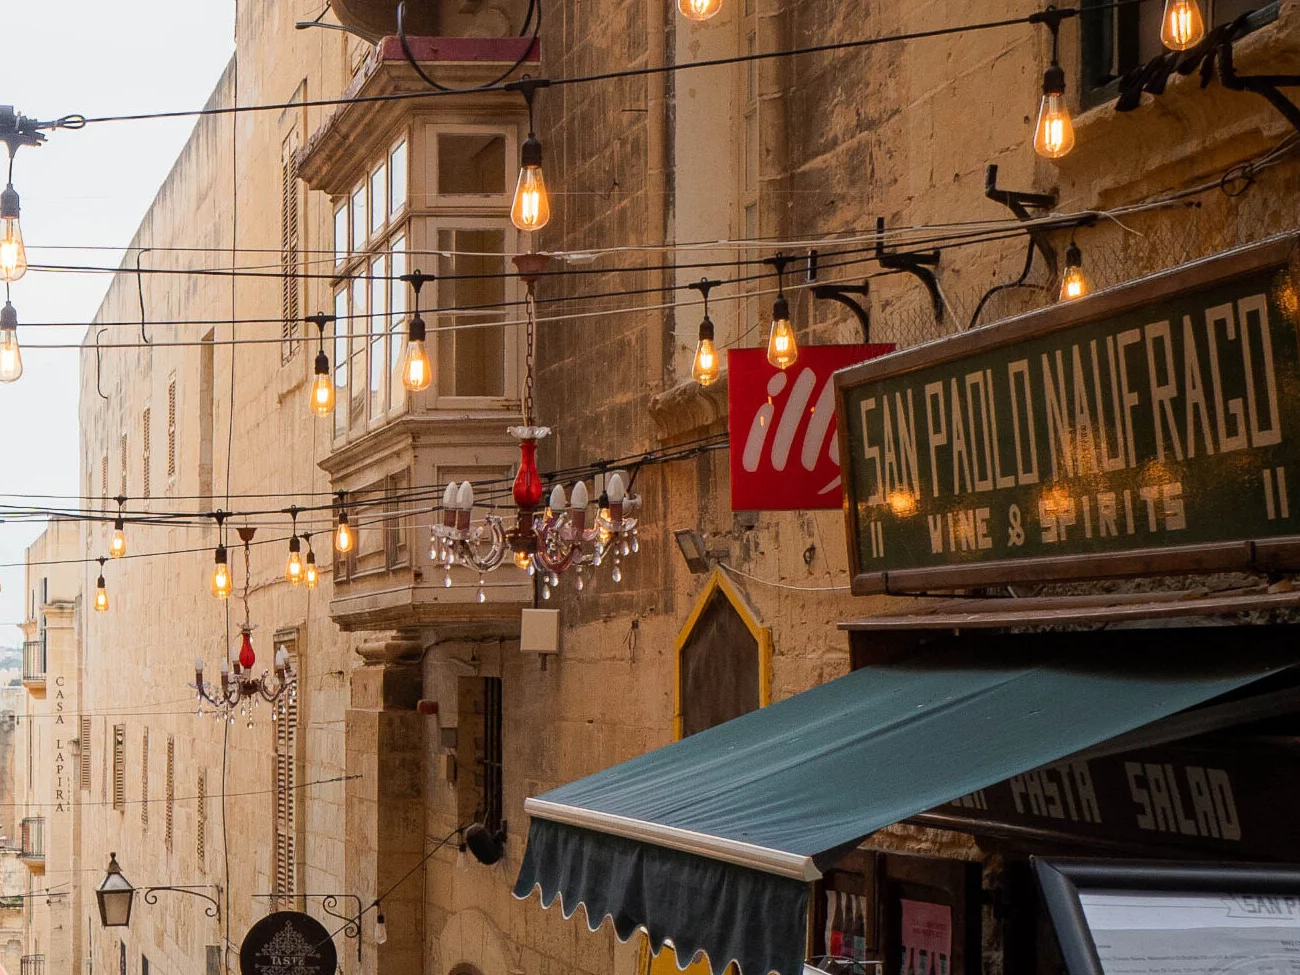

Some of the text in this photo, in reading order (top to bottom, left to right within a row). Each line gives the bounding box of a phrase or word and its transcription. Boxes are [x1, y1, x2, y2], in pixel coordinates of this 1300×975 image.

[860, 293, 1282, 506] SAN PAOLO NAUFRAGO
[927, 507, 993, 555] WINE
[1008, 503, 1025, 547] &
[1038, 482, 1187, 544] SPIRITS
[55, 676, 65, 725] CASA
[1009, 759, 1242, 842] PASTA SALAD
